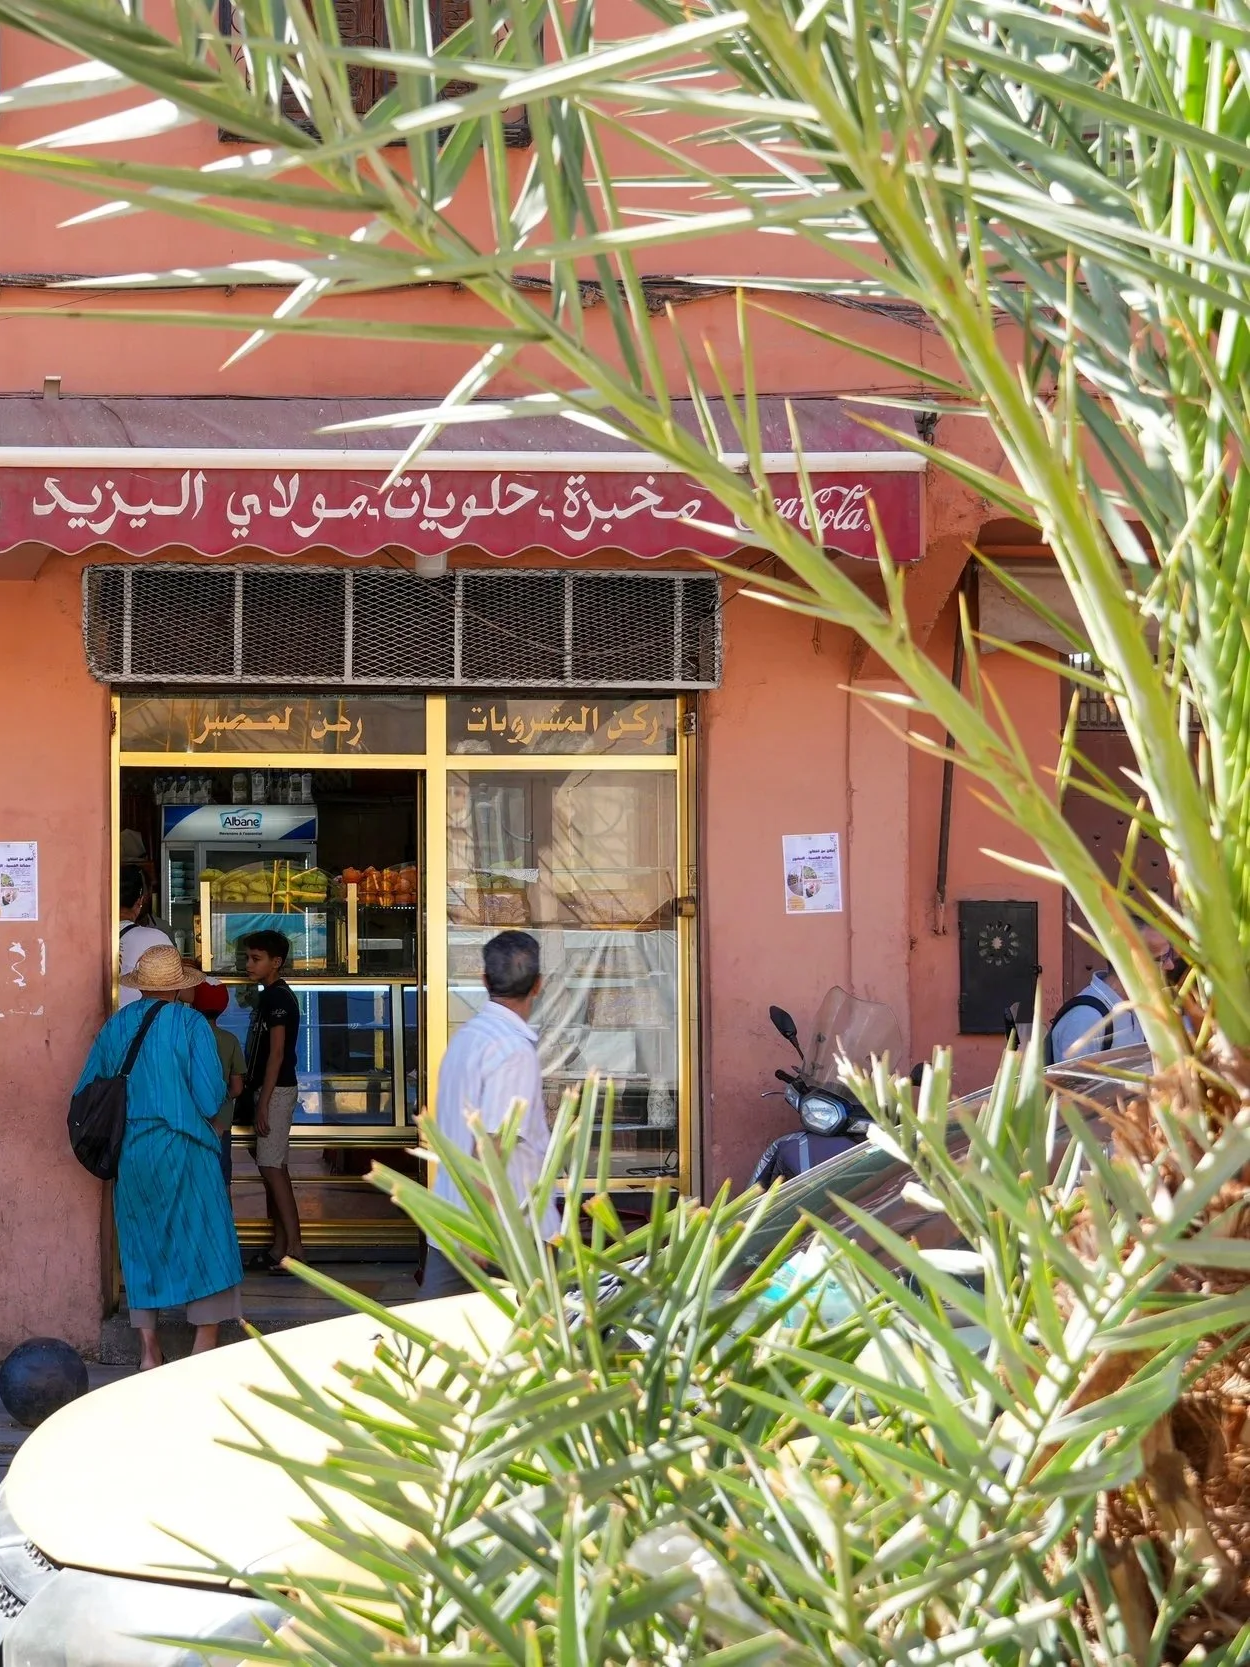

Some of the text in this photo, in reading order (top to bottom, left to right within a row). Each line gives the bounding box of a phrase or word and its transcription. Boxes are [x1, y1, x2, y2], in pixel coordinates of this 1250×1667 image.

[32, 469, 702, 541] مخبزة حلويات مولاي اليزيد
[607, 703, 658, 746] ركن
[223, 816, 261, 827] Albane
